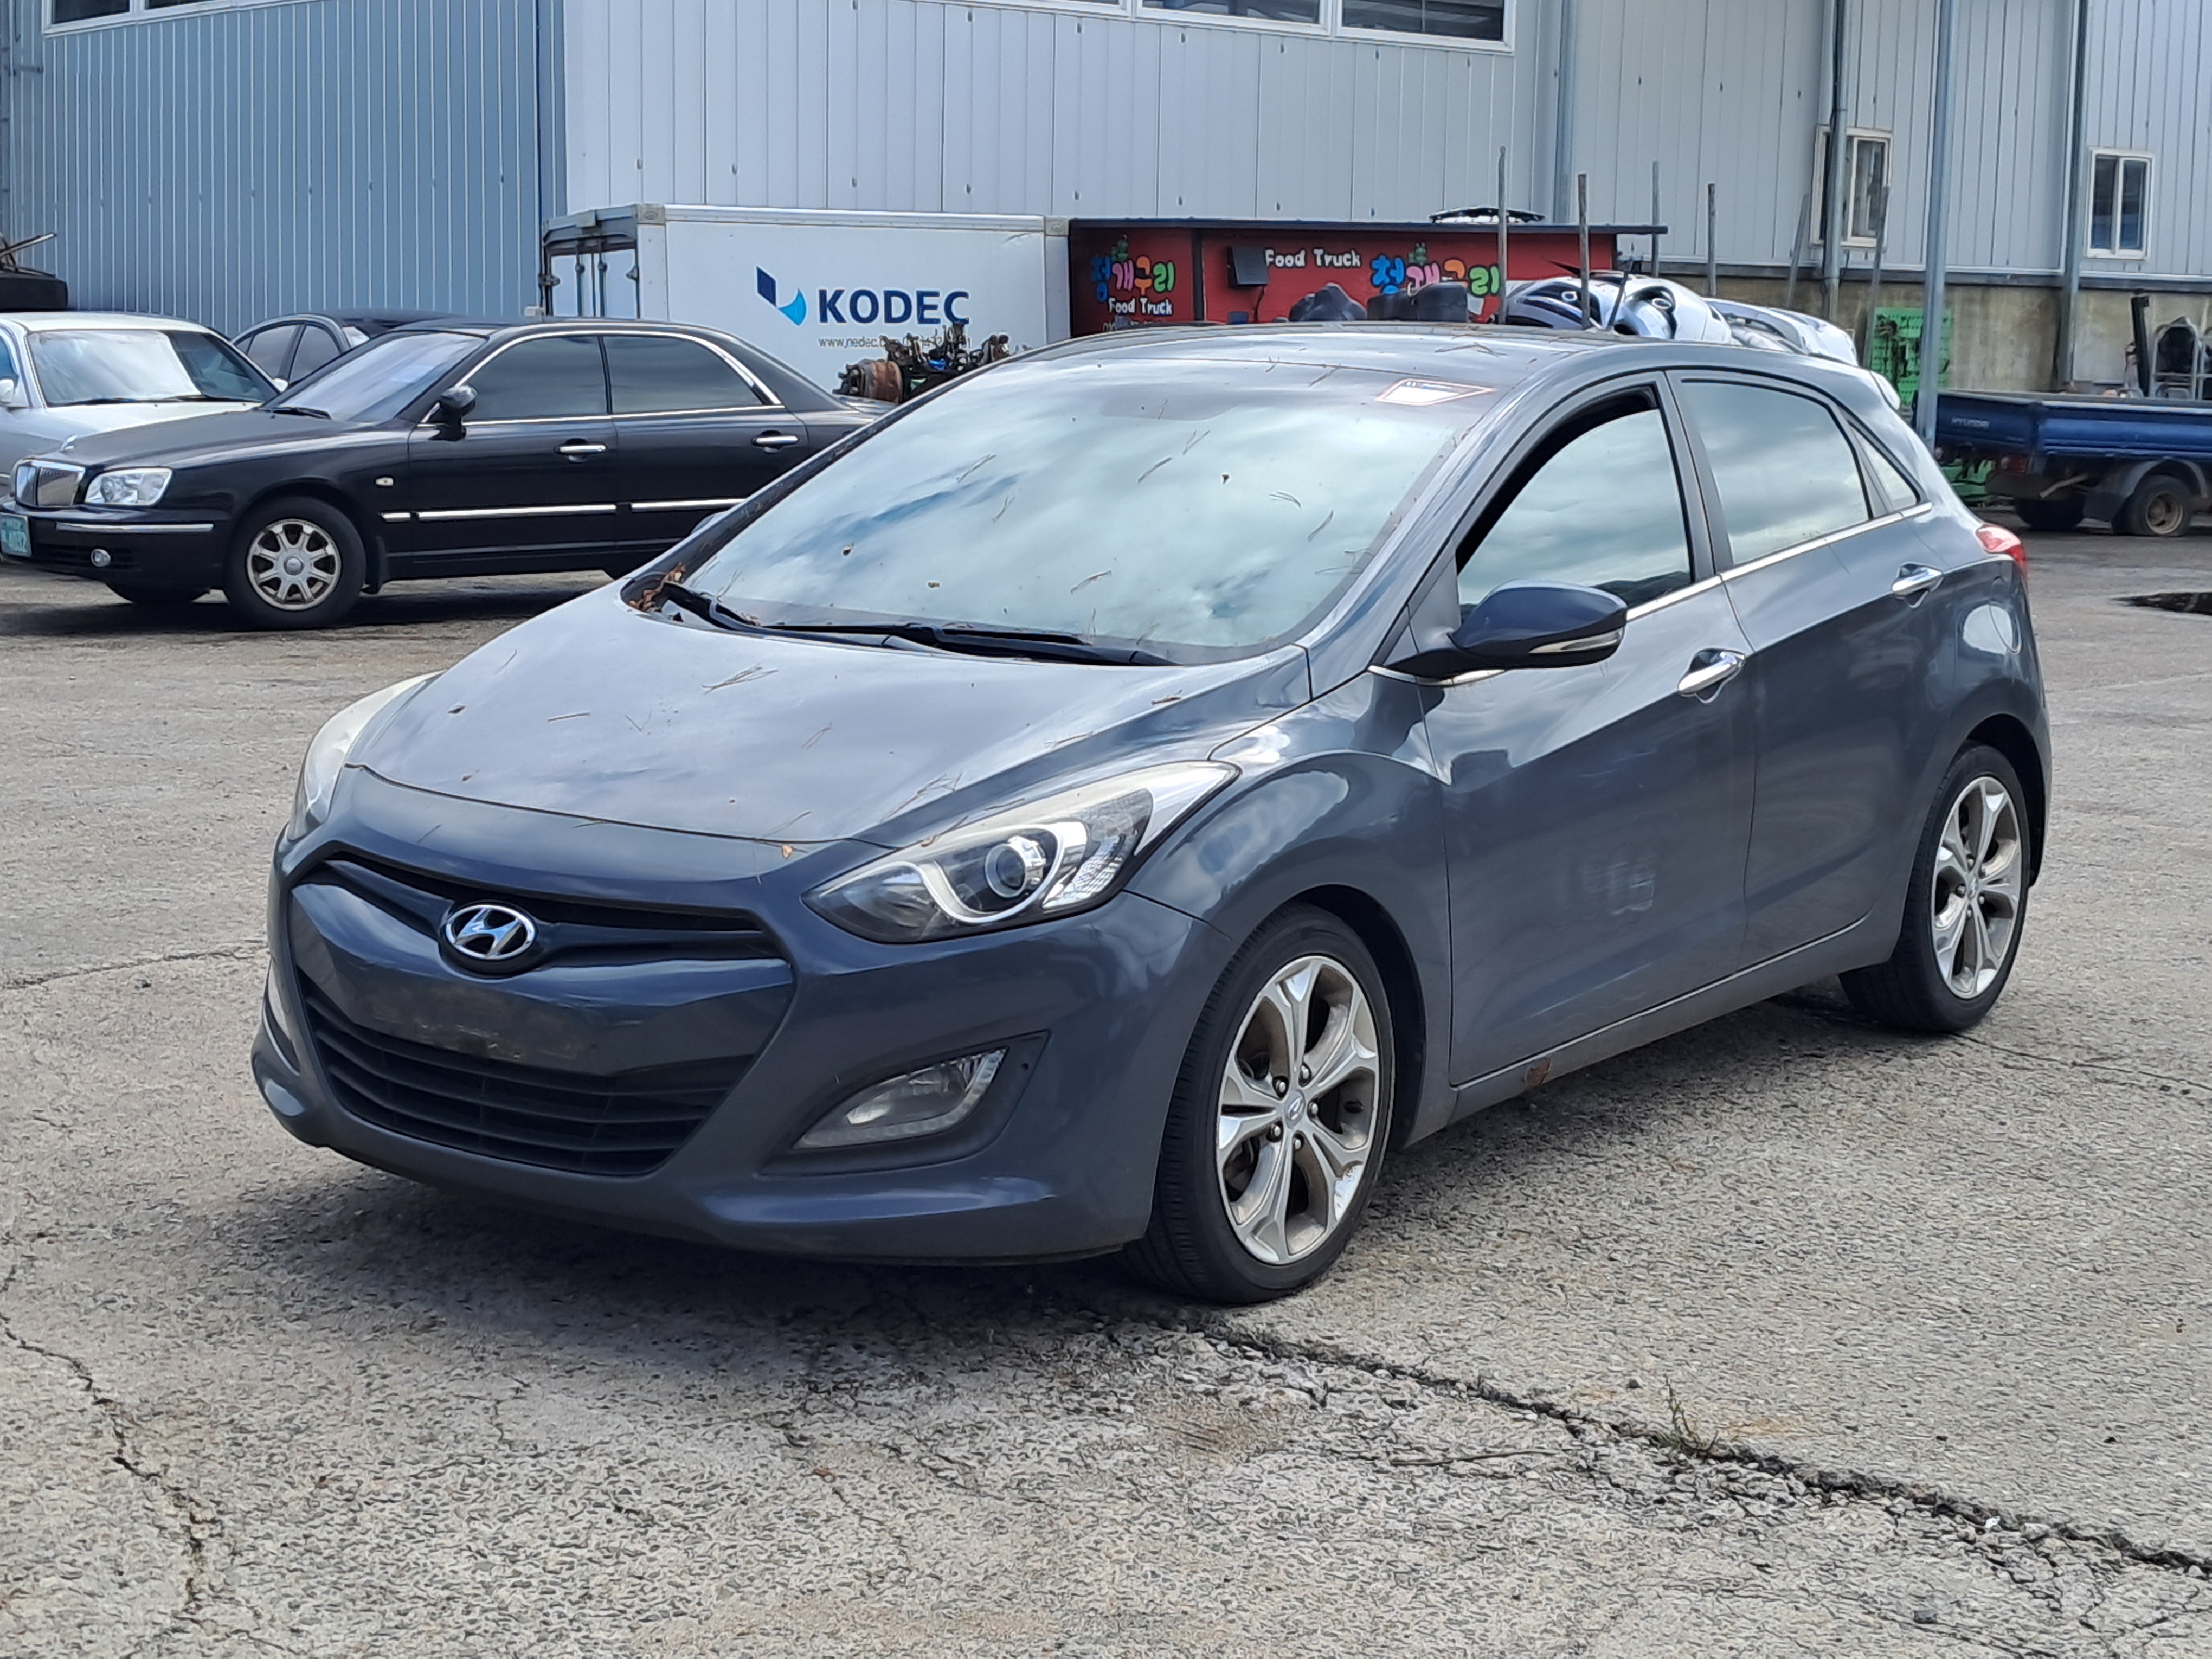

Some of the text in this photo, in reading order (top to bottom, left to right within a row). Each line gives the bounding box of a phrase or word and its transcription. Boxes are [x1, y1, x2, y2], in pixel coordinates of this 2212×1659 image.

[1265, 248, 1361, 267] Food Truck
[1090, 254, 1175, 303] 청개구리
[818, 289, 969, 324] KODEC
[1108, 298, 1173, 314] Food Truck
